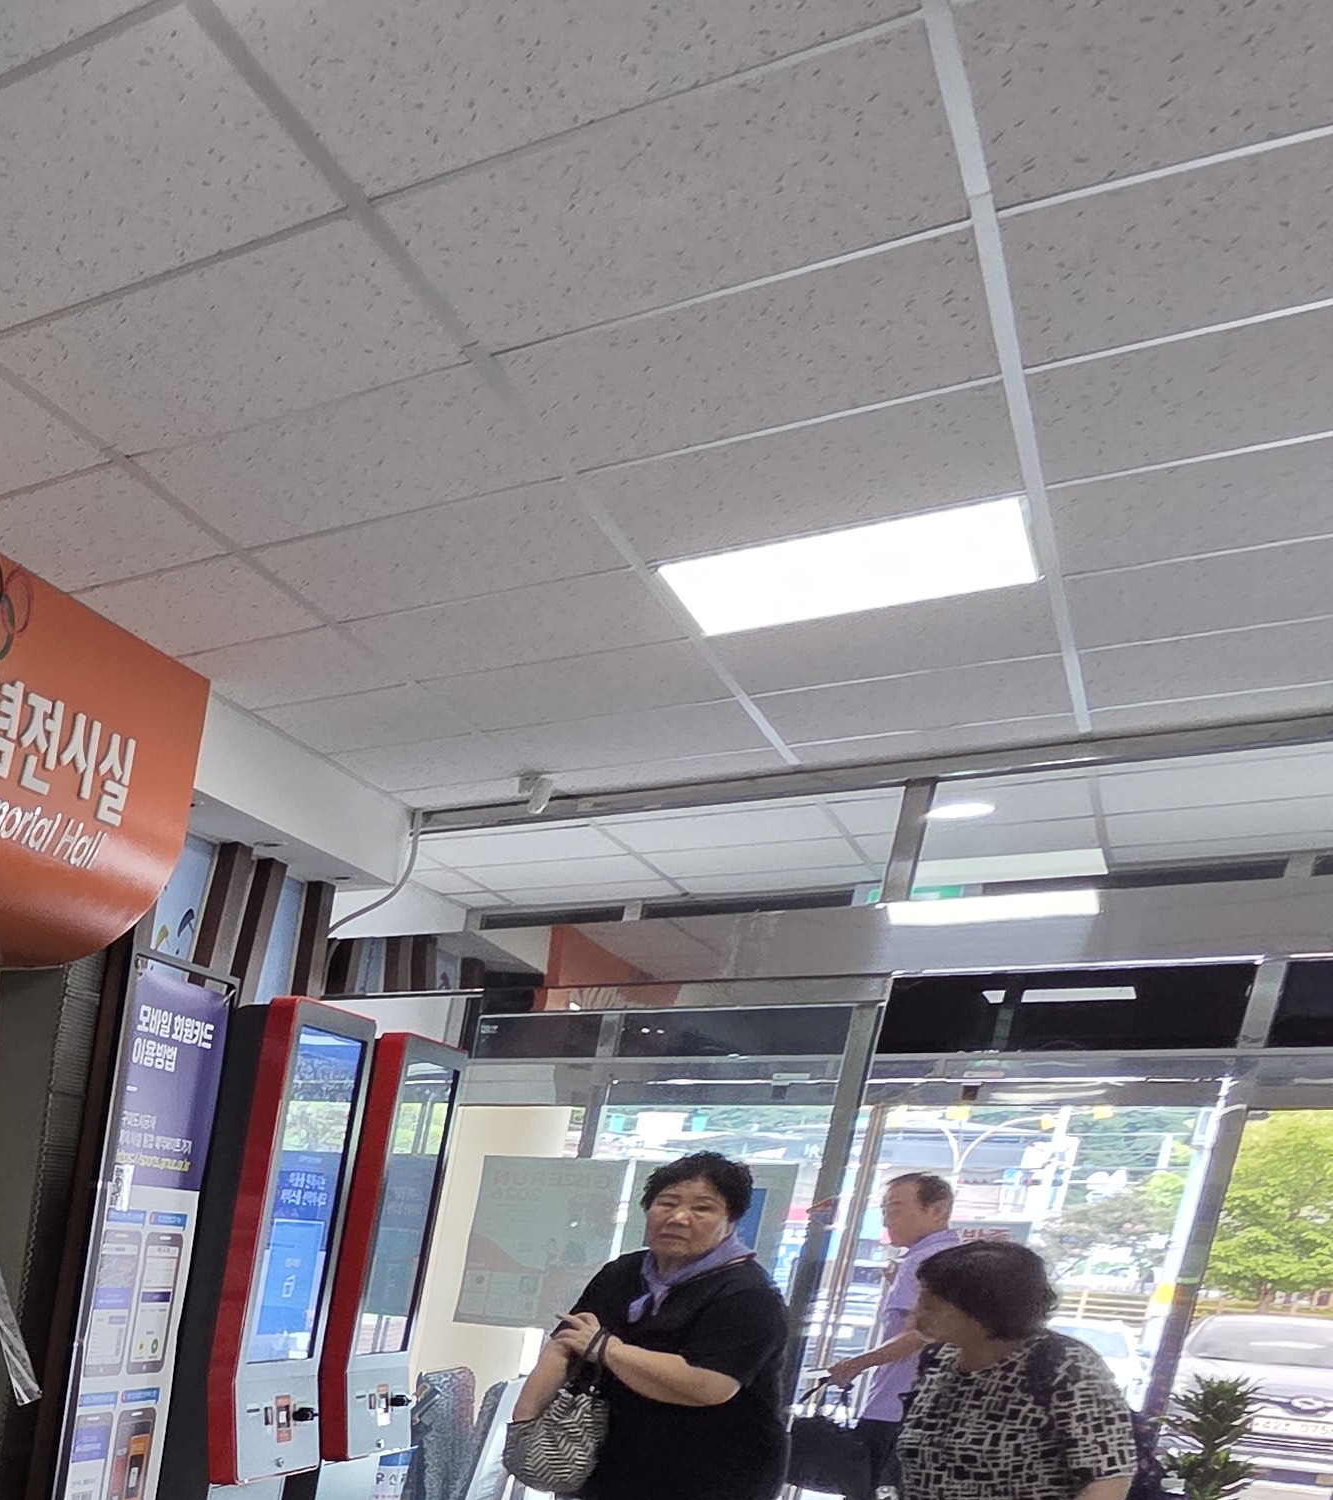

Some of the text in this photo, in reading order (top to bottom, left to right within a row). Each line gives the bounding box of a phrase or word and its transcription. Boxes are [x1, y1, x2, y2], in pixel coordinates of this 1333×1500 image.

[57, 823, 108, 870] Hall
[136, 1004, 216, 1050] 모바일 회원카드
